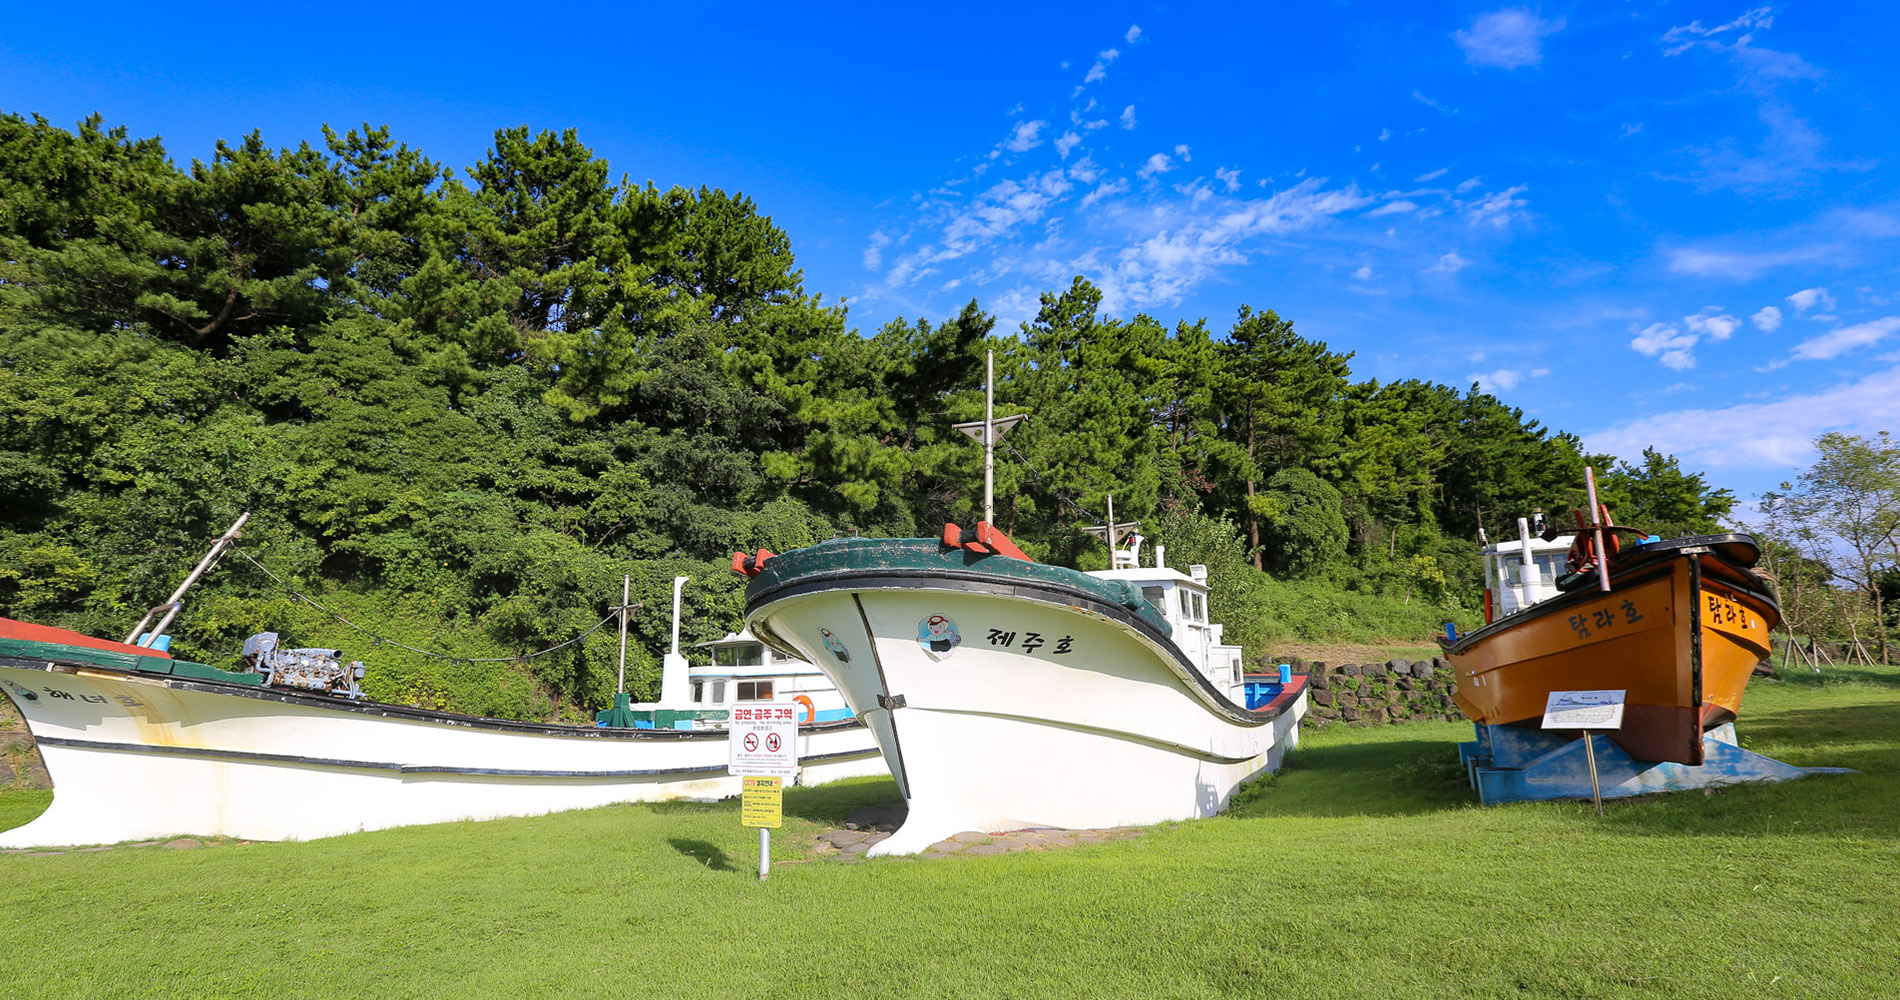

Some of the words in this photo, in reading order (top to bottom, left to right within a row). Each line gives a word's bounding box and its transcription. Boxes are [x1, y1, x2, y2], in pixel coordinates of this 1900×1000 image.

[1568, 599, 1644, 640] 탐라호
[1708, 595, 1748, 630] 탐라호
[987, 628, 1074, 655] 제주호
[42, 686, 144, 707] 해녀호
[735, 708, 772, 720] 금연·금주
[774, 708, 792, 720] 구역
